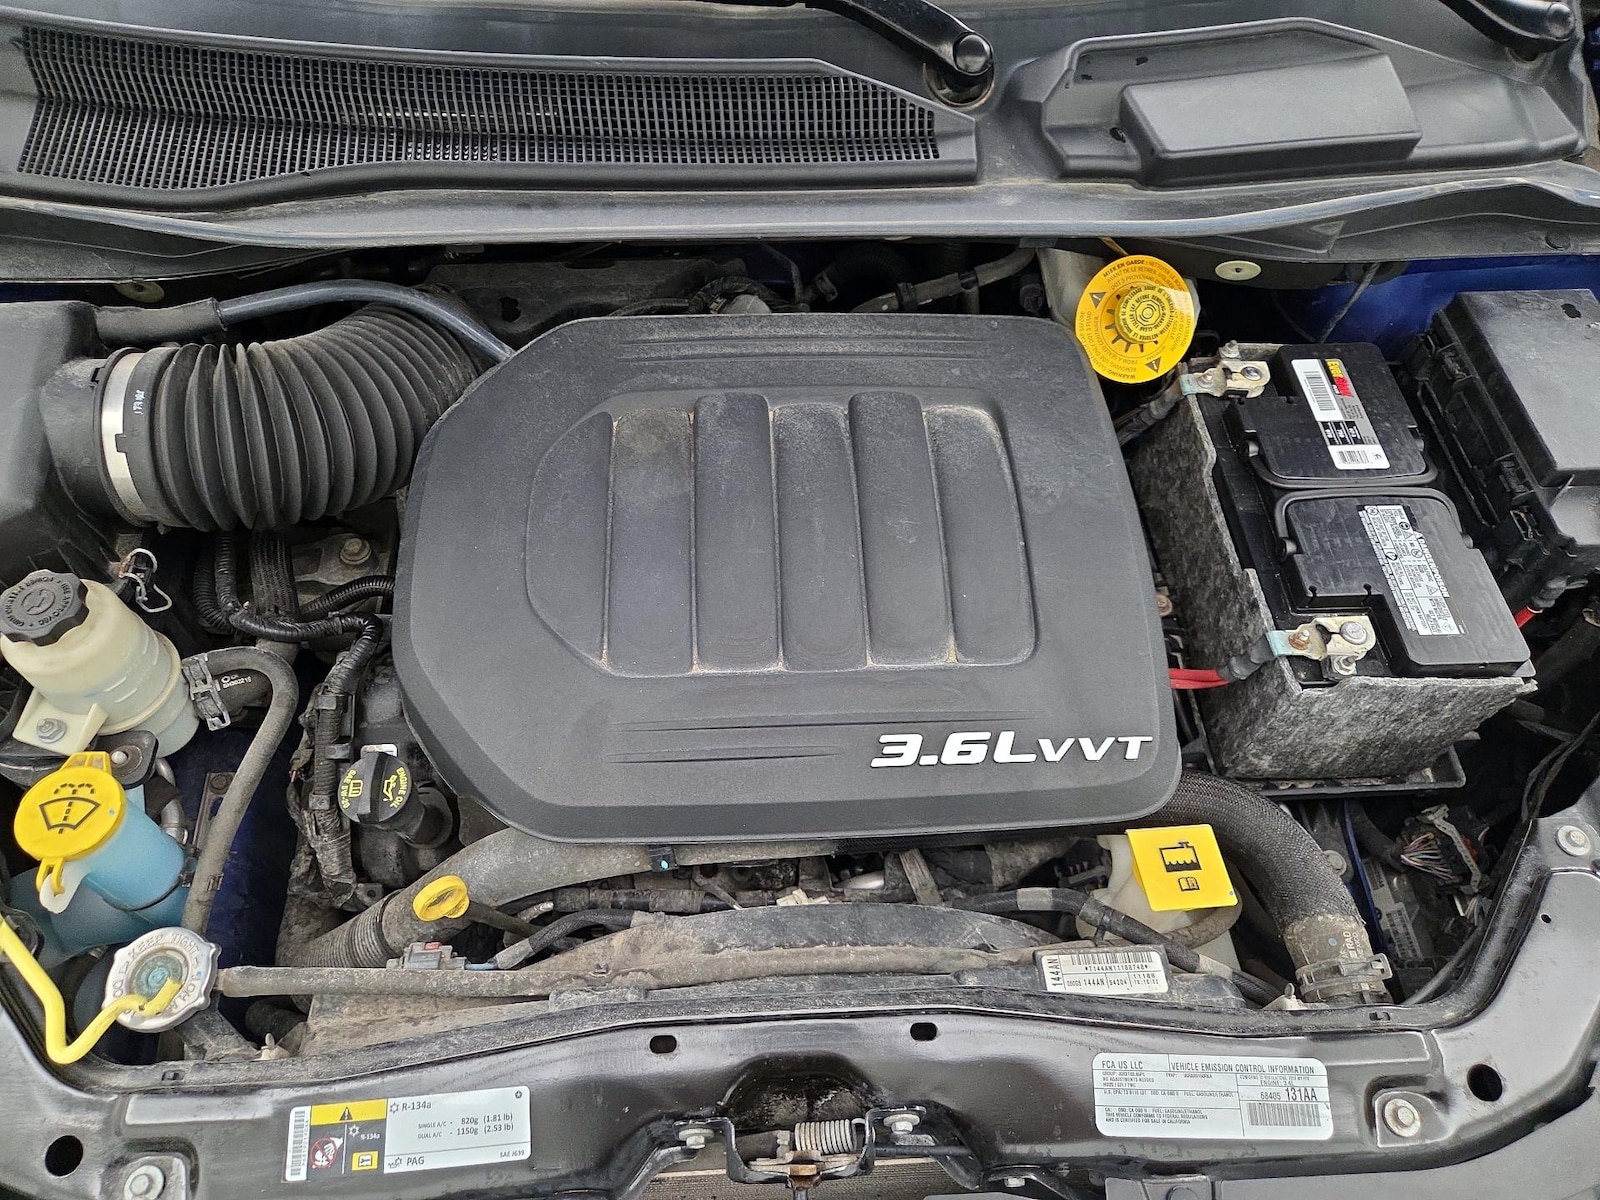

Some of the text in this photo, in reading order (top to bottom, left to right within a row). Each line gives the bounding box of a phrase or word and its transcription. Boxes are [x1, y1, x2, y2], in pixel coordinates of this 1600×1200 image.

[870, 730, 1154, 768] 3.6L VVT
[340, 769, 356, 809] SAE 5W-20
[390, 767, 408, 808] ENGINE OIL
[128, 934, 163, 958] KEEP
[1047, 959, 1063, 986] 144AN
[1102, 1061, 1143, 1070] FCA US LLC
[1201, 1063, 1233, 1072] EMISSION
[1235, 1064, 1265, 1072] CONTROL
[1268, 1065, 1314, 1074] INFORMATION
[1260, 1087, 1318, 1101] 68405 131AA
[402, 1101, 432, 1111] R-134a
[461, 1117, 479, 1126] 820g
[483, 1114, 501, 1124] (1.81
[503, 1112, 513, 1122] lb)
[457, 1127, 478, 1136] 1150g
[484, 1124, 502, 1134] (2.53
[504, 1122, 514, 1132] lb)
[406, 1156, 425, 1166] PAG
